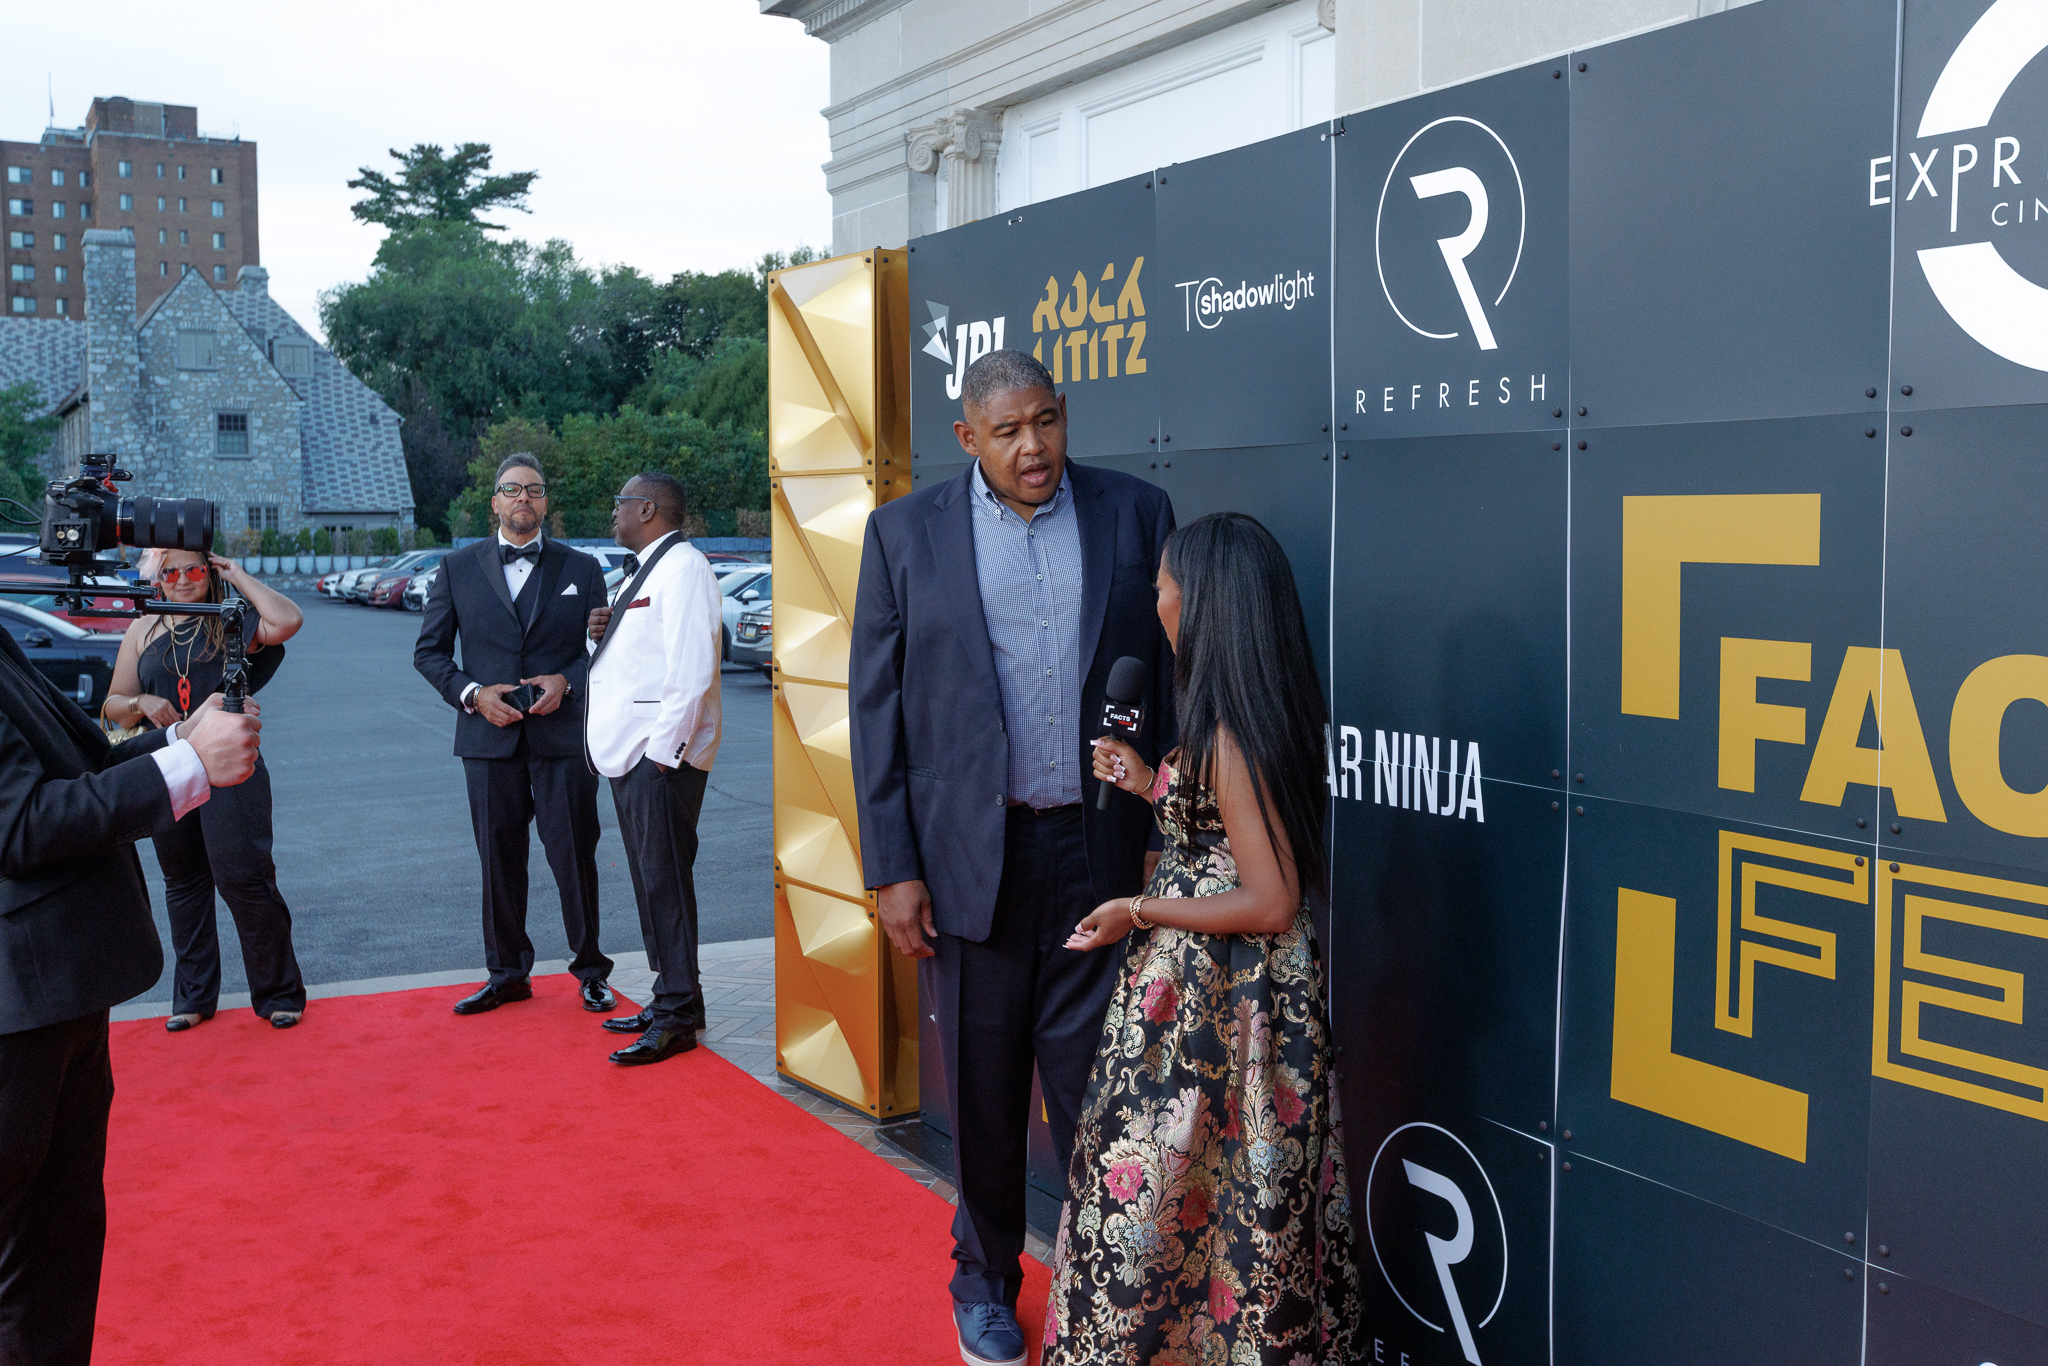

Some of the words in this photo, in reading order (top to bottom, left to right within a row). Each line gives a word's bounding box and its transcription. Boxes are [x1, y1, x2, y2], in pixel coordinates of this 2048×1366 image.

[1869, 136, 2048, 232] EXPR
[1032, 256, 1146, 333] ROCK
[1356, 374, 1545, 414] REFRESH
[1110, 713, 1131, 722] FACTS
[1374, 729, 1485, 824] NINJA
